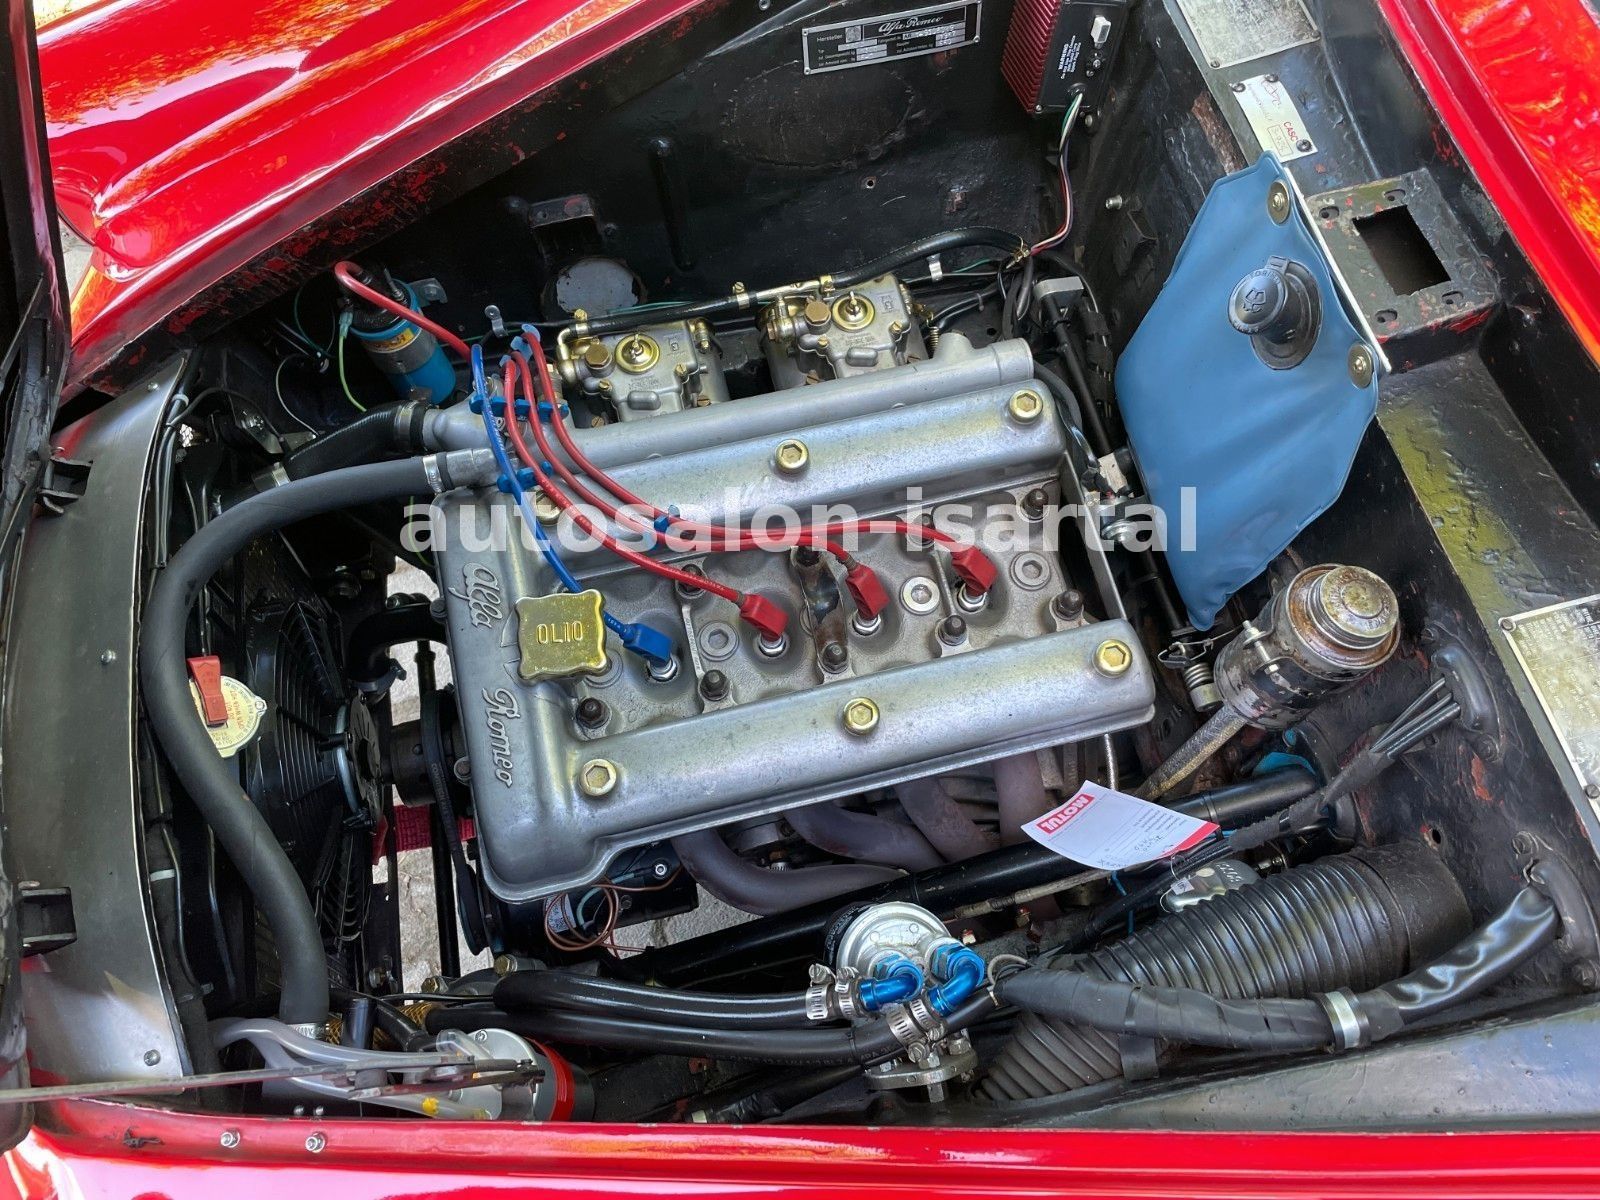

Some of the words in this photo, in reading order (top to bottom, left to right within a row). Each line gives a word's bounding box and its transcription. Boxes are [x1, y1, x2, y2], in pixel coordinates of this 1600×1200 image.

[878, 20, 905, 36] Alfa
[905, 16, 944, 28] Romeo
[1284, 121, 1298, 141] CASC
[535, 620, 584, 645] OLIO
[482, 687, 521, 789] Romeo
[1041, 794, 1091, 832] MOTUL
